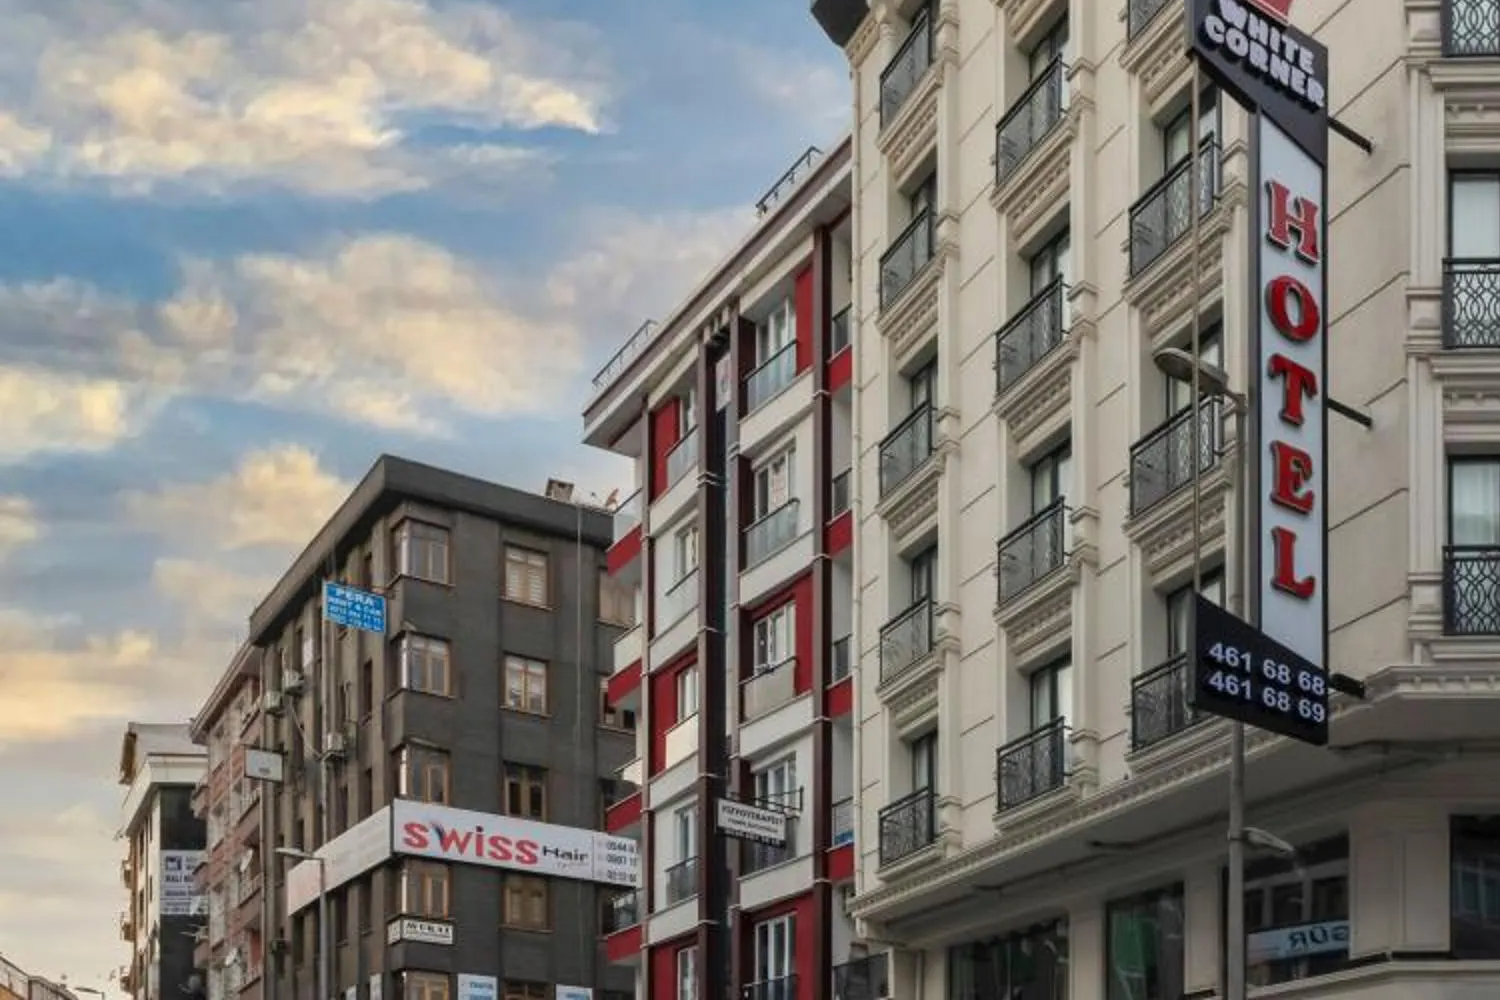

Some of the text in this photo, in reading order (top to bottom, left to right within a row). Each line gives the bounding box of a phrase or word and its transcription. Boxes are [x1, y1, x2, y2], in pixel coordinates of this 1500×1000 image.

[1205, 14, 1325, 107] CORNER
[1266, 179, 1320, 600] HOTEL
[1208, 643, 1325, 696] 461 68 68
[1208, 671, 1325, 723] 461 68 69
[542, 844, 589, 862] Hair
